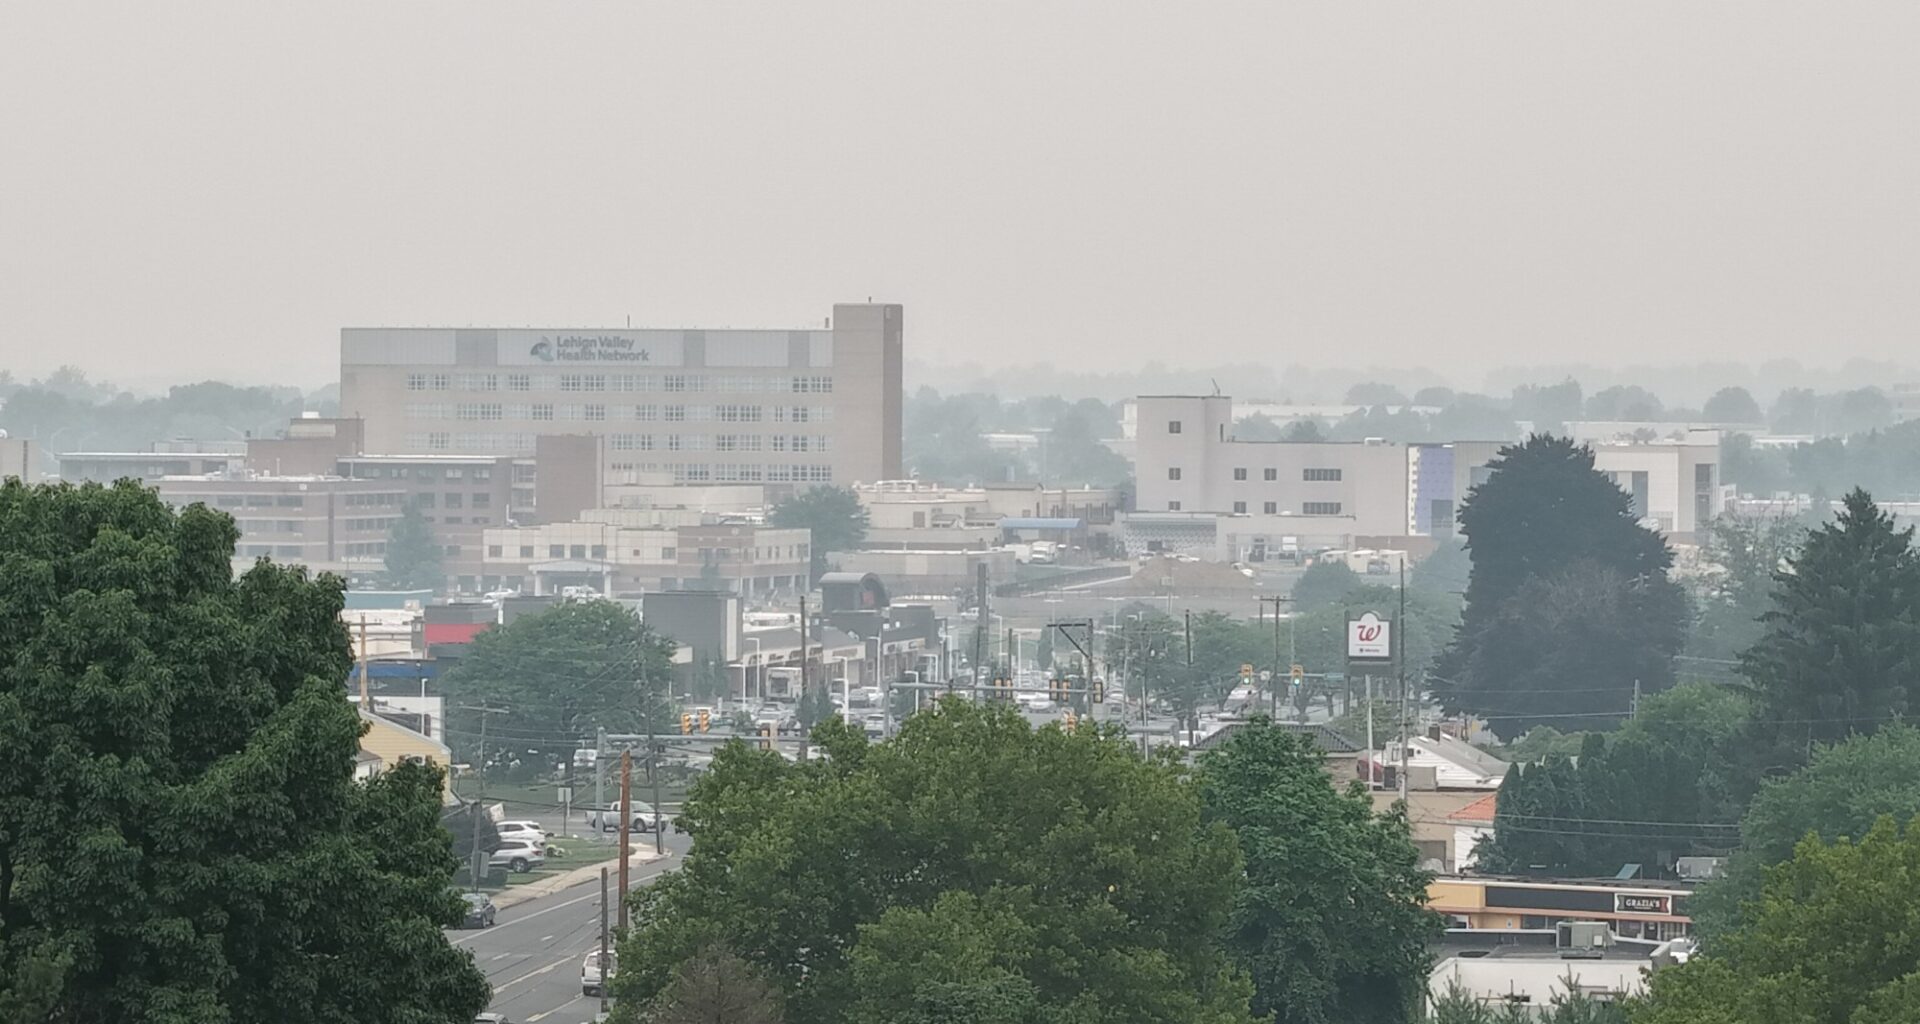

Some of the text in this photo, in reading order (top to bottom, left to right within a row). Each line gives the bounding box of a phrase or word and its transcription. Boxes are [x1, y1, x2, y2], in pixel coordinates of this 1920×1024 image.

[598, 336, 635, 350] Valley
[557, 349, 649, 361] Health Network
